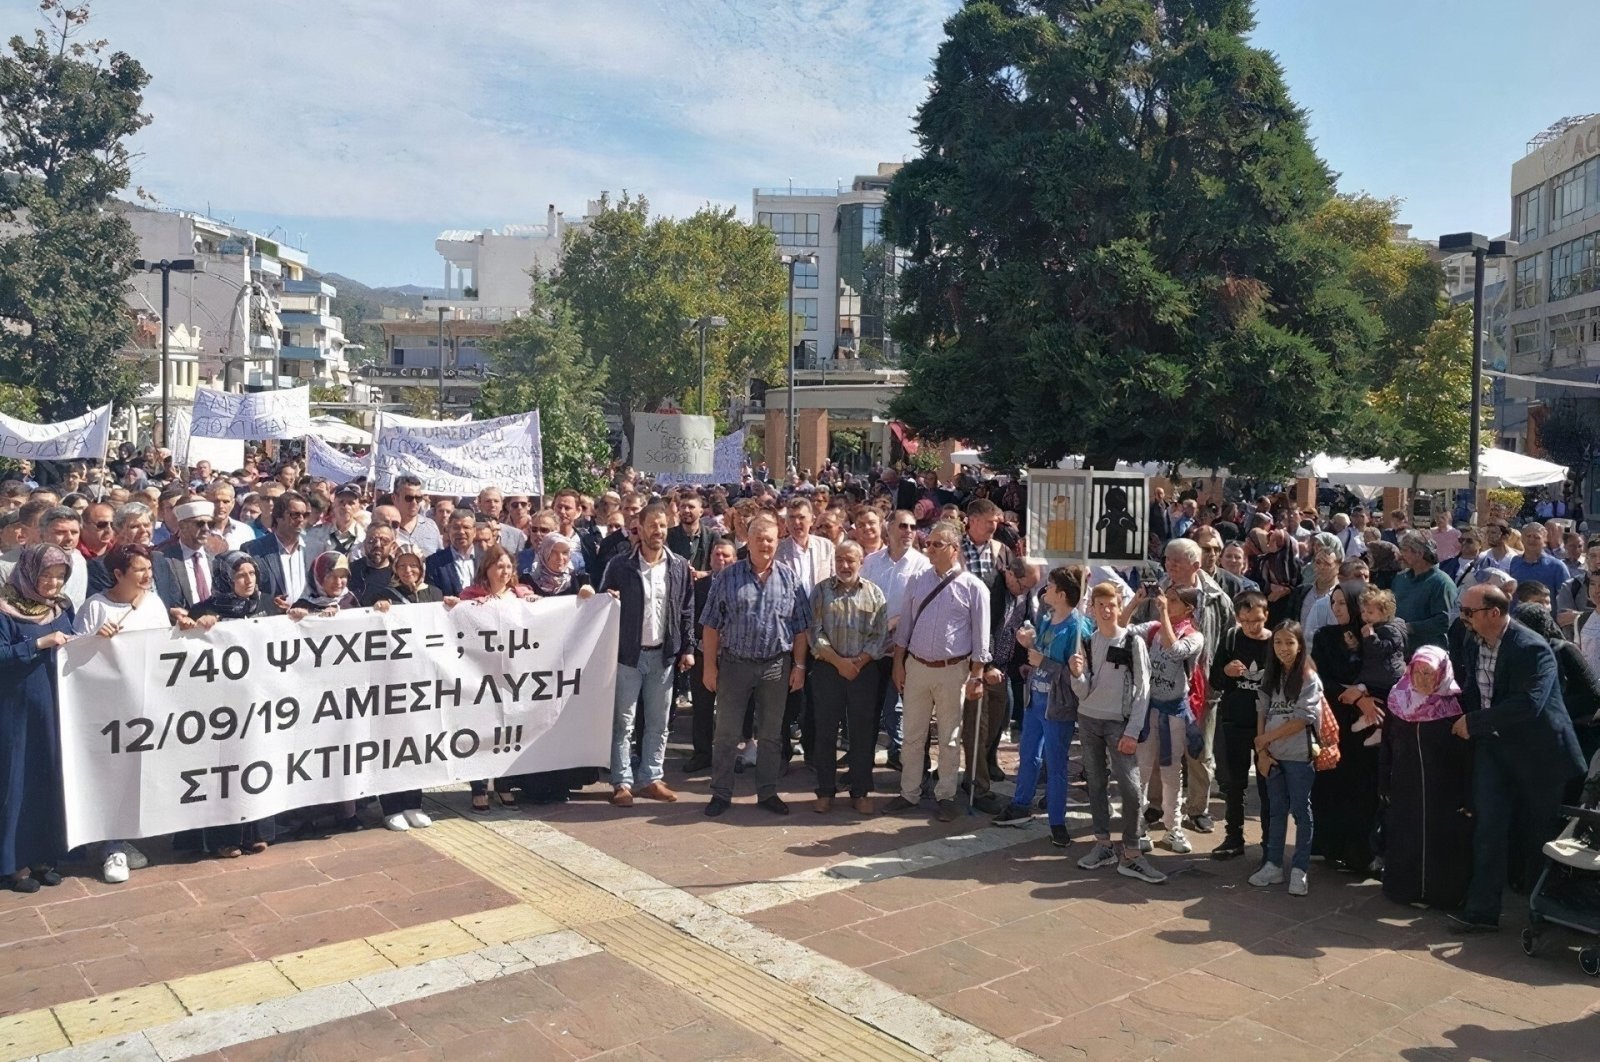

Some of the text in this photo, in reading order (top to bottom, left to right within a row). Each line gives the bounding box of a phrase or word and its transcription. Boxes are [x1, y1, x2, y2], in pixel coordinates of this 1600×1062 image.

[159, 646, 249, 687] 740
[267, 628, 413, 673] ΨΥΧΕΣ
[477, 628, 540, 659] τ.μ.
[100, 668, 581, 754] 12/09/19 ΑΜΕΣΗ ΛΥΣΗ
[180, 724, 523, 804] ΣΤΟ ΚΤΙΡΙΑΚΟ !!!
